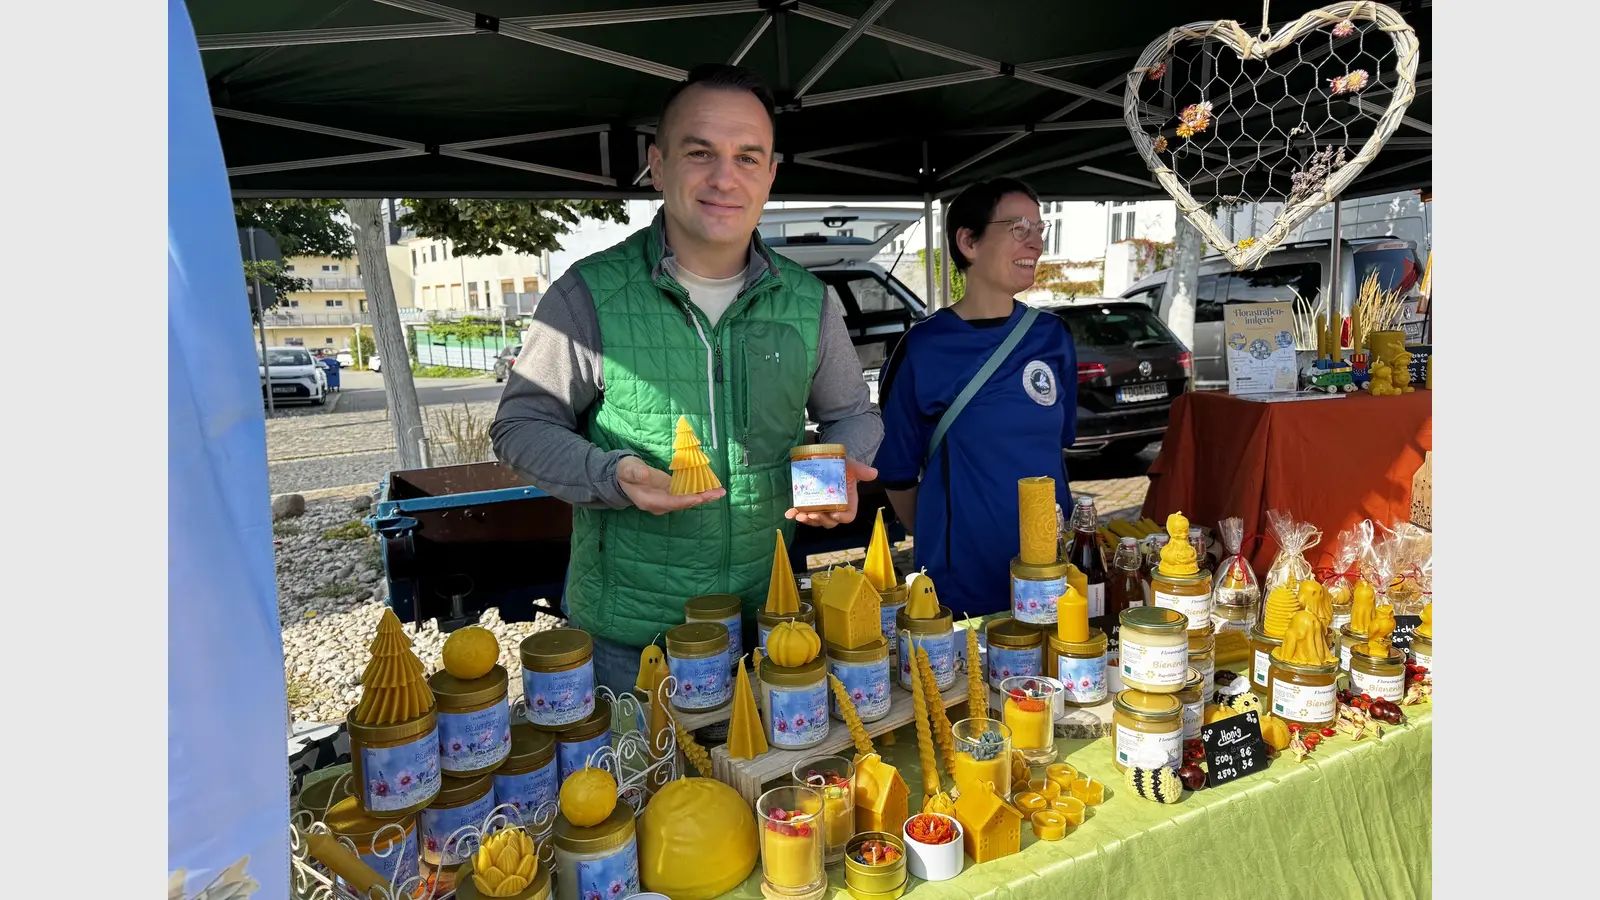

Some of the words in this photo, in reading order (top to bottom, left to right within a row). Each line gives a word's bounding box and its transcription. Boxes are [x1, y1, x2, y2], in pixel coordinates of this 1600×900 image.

[1245, 316, 1274, 325] imkerei
[1221, 726, 1242, 742] Honig
[1215, 754, 1233, 766] 500g
[1240, 746, 1252, 758] 8€
[1217, 767, 1237, 780] 250g
